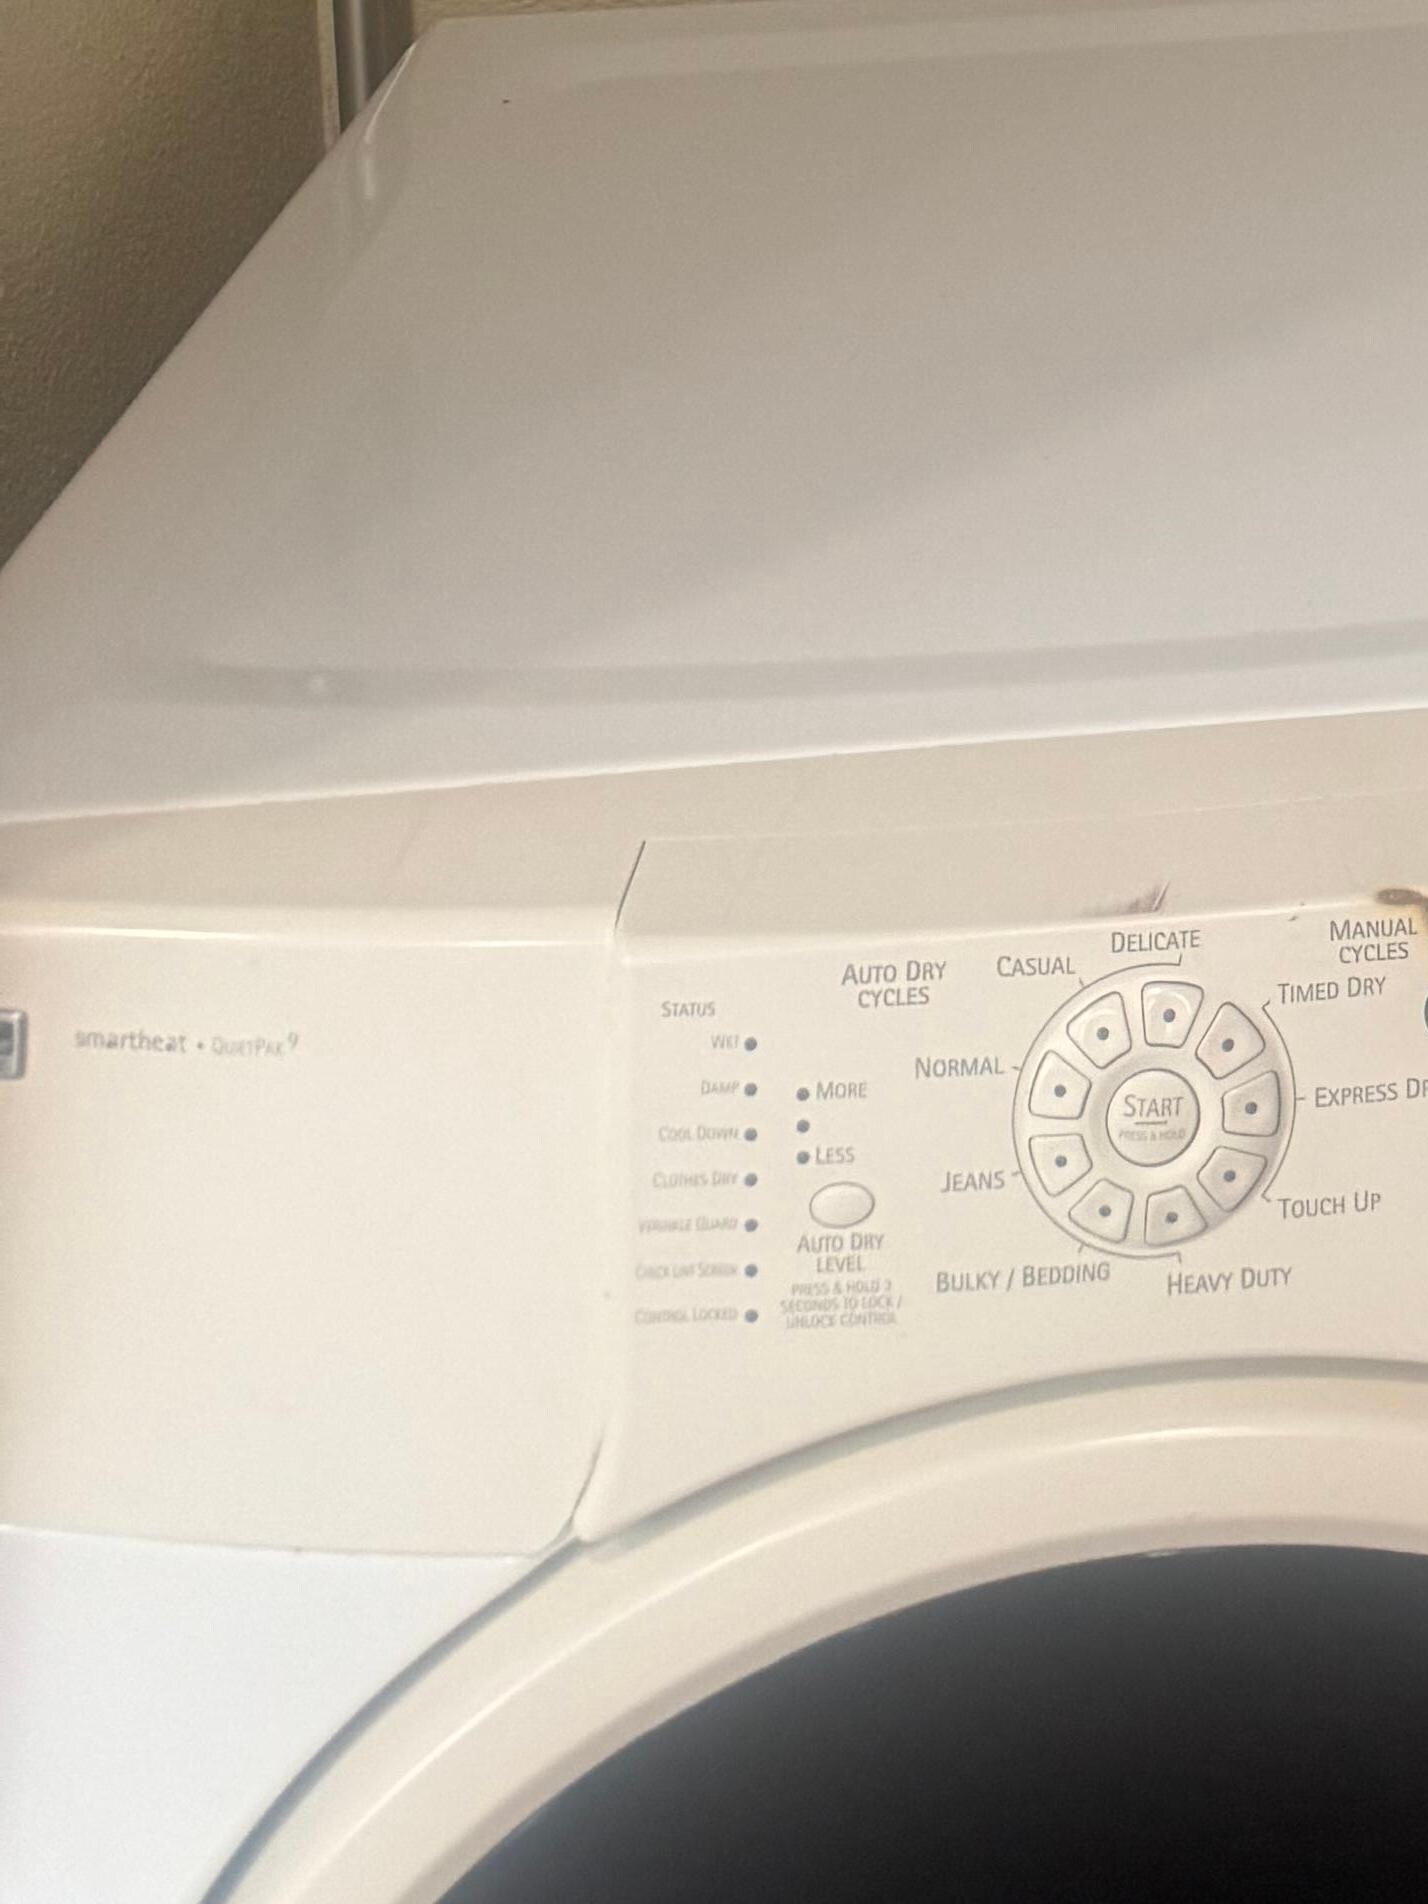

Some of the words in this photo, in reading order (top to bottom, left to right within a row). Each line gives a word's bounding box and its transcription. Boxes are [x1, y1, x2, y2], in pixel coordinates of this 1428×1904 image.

[1111, 929, 1200, 952] DELICATE
[1329, 919, 1417, 941] MANUAL
[1339, 941, 1409, 963] CYCLES
[841, 963, 897, 985] AUTO
[904, 960, 946, 981] DRY
[997, 955, 1075, 978] CASUAL
[858, 985, 930, 1008] CYCLES
[1278, 980, 1341, 1004] TIMED
[1347, 976, 1386, 998] DRY
[661, 1002, 716, 1017] STATUS
[915, 1056, 1005, 1078] NORMAL
[816, 1083, 867, 1099] MORE
[1315, 1082, 1399, 1106] EXPRESS
[1123, 1094, 1184, 1117] START
[815, 1148, 855, 1164] LESS
[941, 1170, 1005, 1194] JEANS
[1278, 1195, 1346, 1219] TOUCH
[1353, 1191, 1382, 1214] UP
[797, 1235, 843, 1253] AUTO
[850, 1233, 884, 1250] DRY
[817, 1257, 864, 1272] LEVEL
[936, 1269, 1000, 1293] BULKY
[1022, 1262, 1110, 1287] BEDDING
[1167, 1271, 1234, 1296] HEAVY
[1240, 1266, 1292, 1291] DUTY
